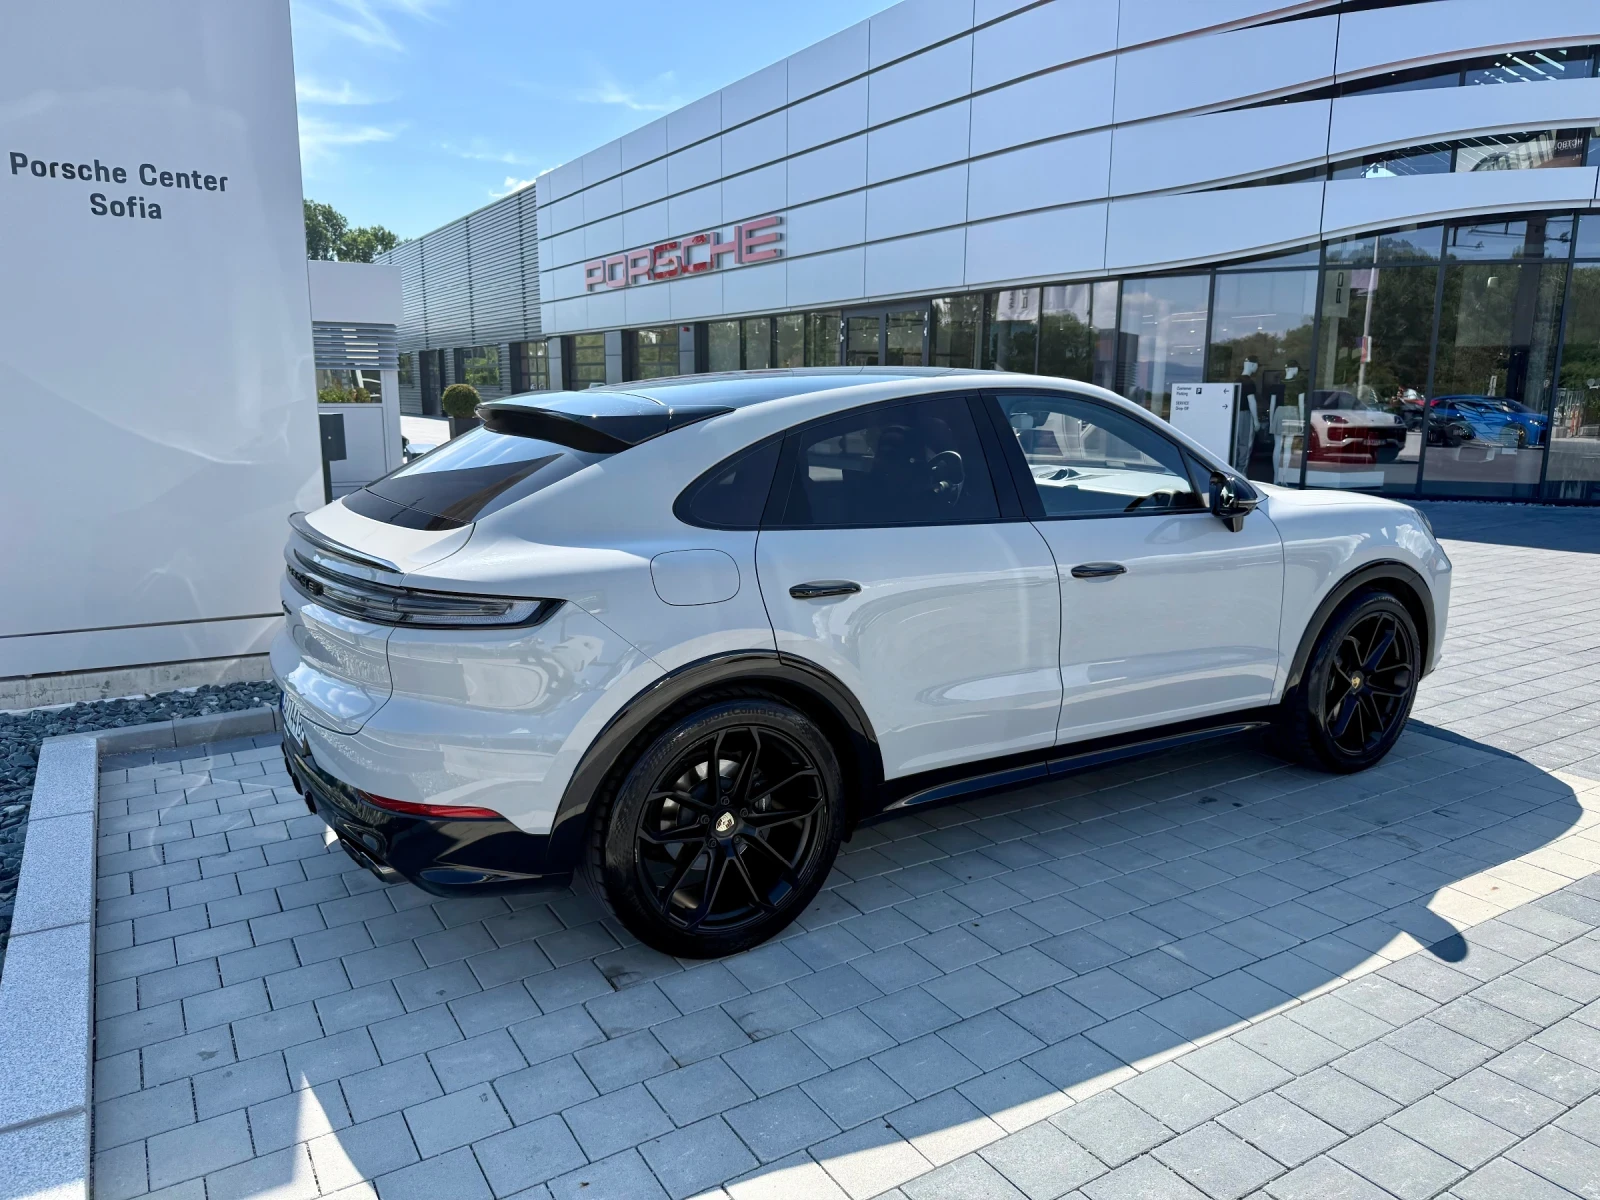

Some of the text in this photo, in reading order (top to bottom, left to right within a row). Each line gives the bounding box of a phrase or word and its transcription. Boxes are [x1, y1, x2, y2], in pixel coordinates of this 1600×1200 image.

[9, 151, 229, 192] Porsche Center
[89, 192, 162, 220] Sofia
[584, 216, 785, 292] PORSCHE
